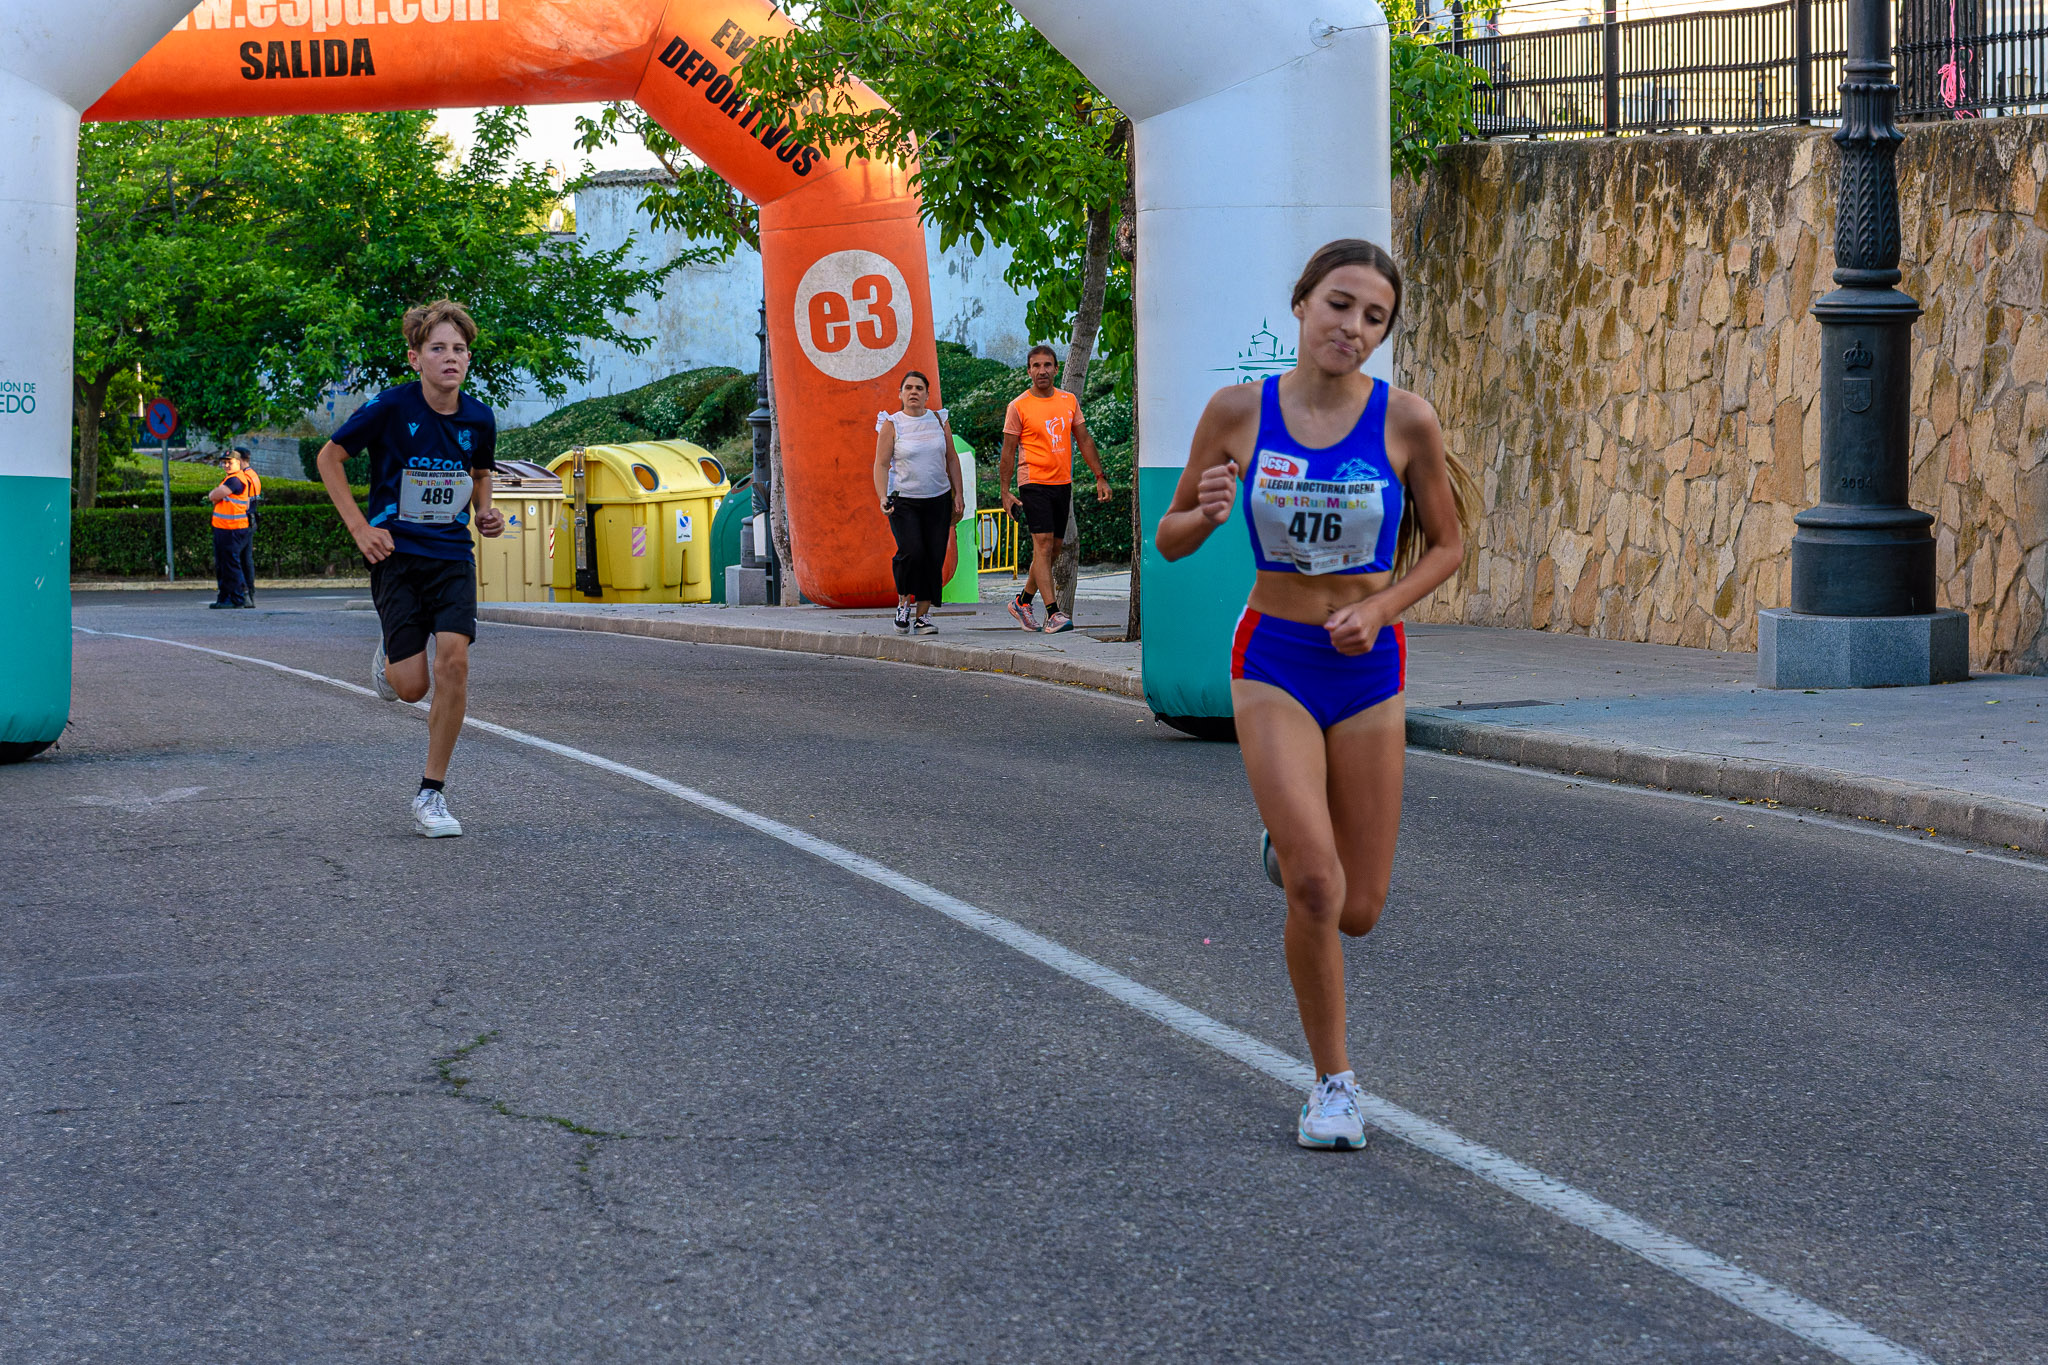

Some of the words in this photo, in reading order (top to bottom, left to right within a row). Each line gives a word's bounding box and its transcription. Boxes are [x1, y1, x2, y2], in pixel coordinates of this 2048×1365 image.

[240, 38, 376, 80] SALIDA
[808, 274, 898, 353] e3
[23, 383, 36, 393] DE
[421, 488, 454, 504] 489
[1267, 479, 1294, 491] LEGUA
[1295, 481, 1346, 494] NOCTURNA
[1348, 483, 1375, 495] UGENA
[1289, 511, 1342, 544] 476
